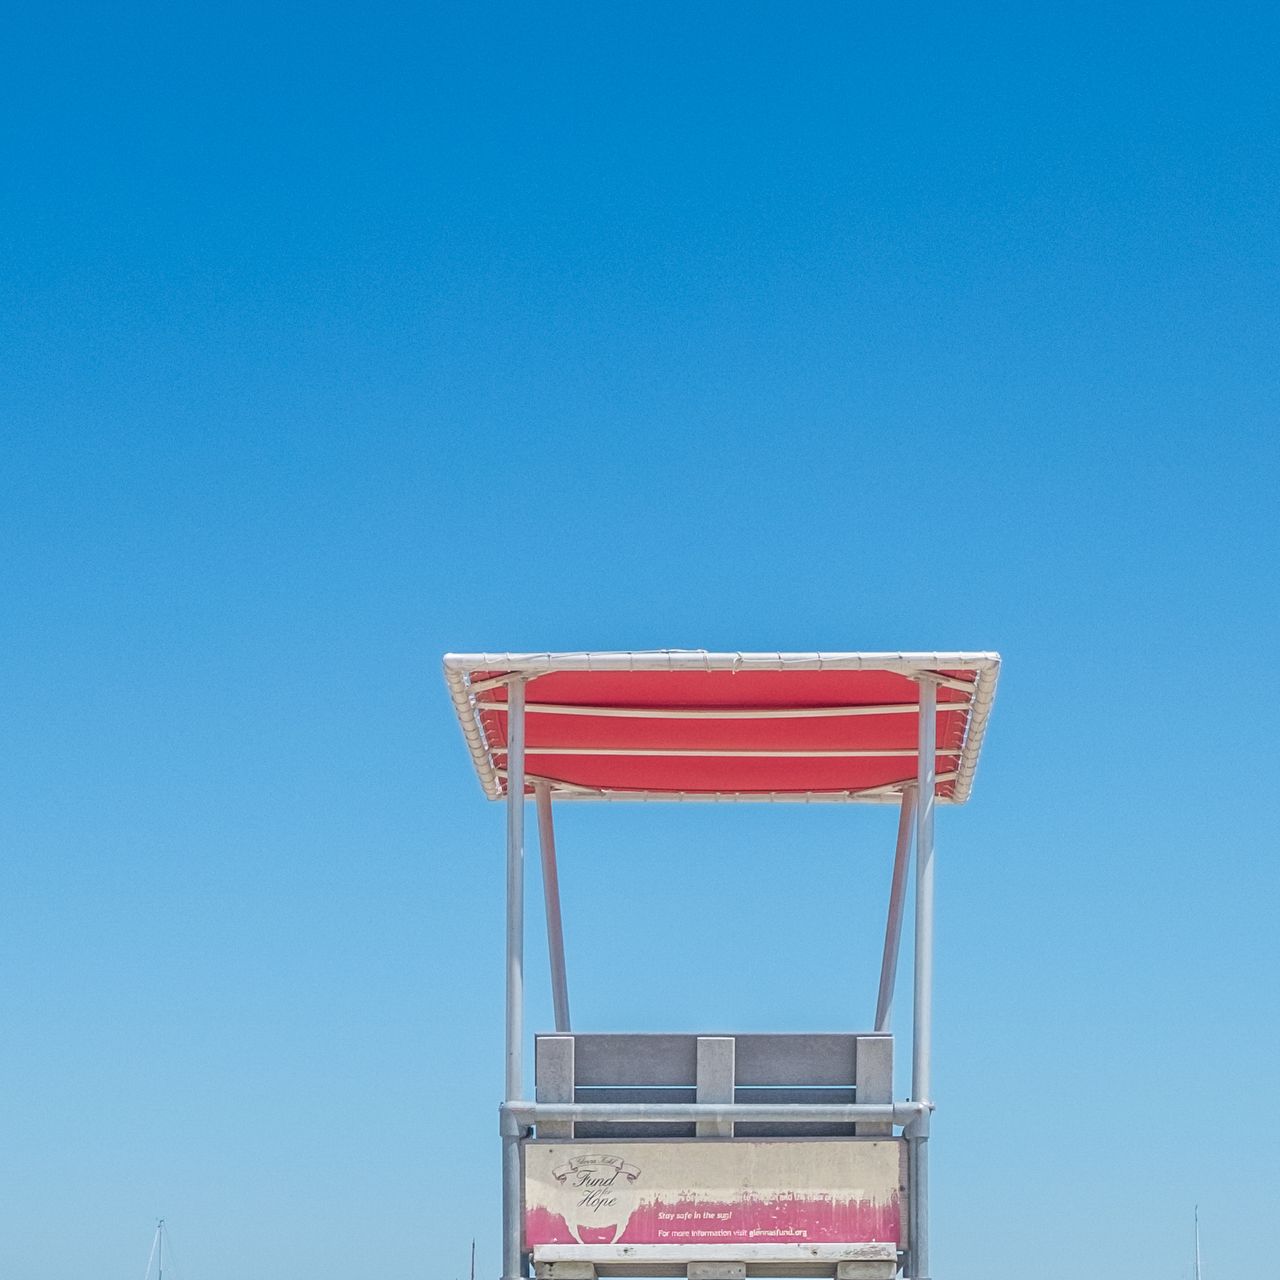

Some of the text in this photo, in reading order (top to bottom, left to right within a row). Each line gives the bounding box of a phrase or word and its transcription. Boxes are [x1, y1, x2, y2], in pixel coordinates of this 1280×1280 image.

[573, 1169, 619, 1188] Fund
[577, 1189, 617, 1213] Hope
[658, 1211, 675, 1221] Stay
[676, 1211, 693, 1220] safe
[694, 1211, 702, 1219] in
[703, 1211, 716, 1219] the
[733, 1229, 747, 1237] visit
